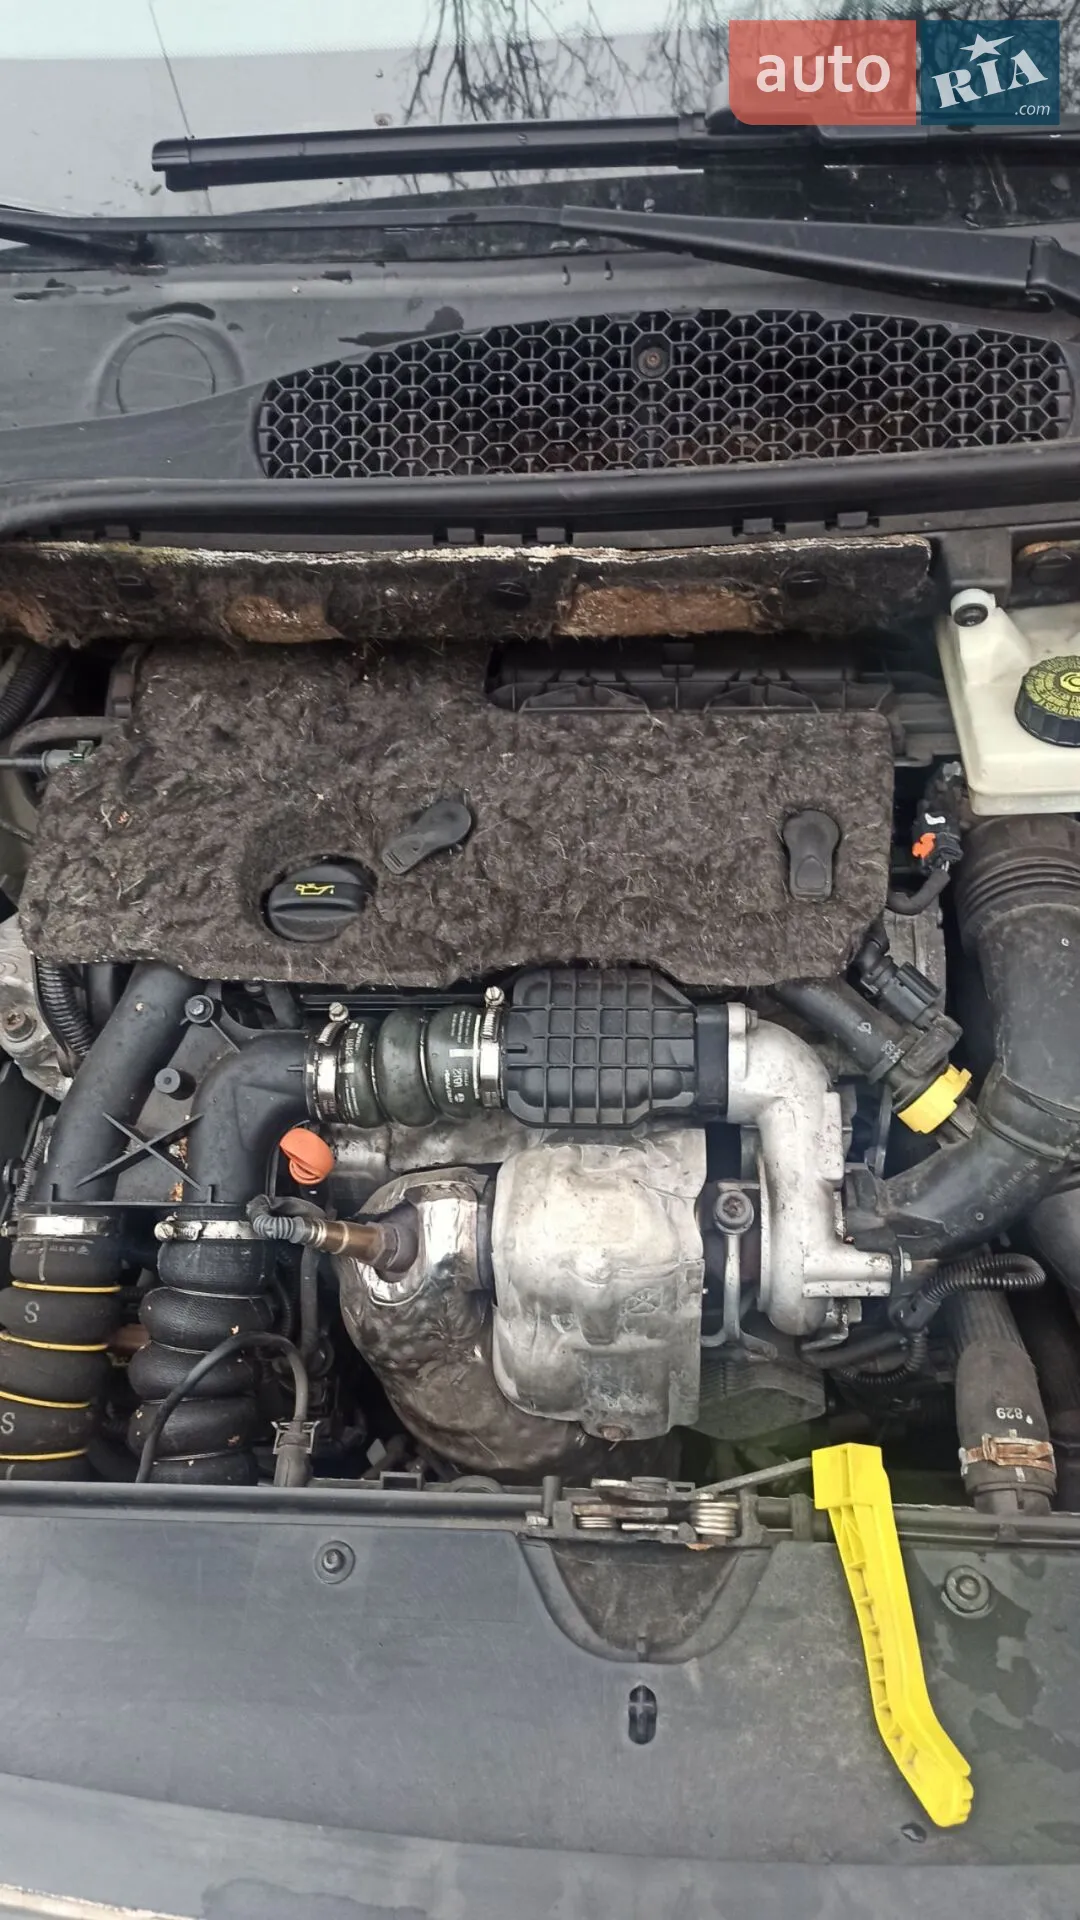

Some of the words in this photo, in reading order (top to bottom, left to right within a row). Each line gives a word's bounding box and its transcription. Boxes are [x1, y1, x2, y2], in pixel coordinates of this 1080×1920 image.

[24, 1302, 40, 1323] S
[0, 1412, 15, 1434] S
[995, 1407, 1024, 1419] 829
